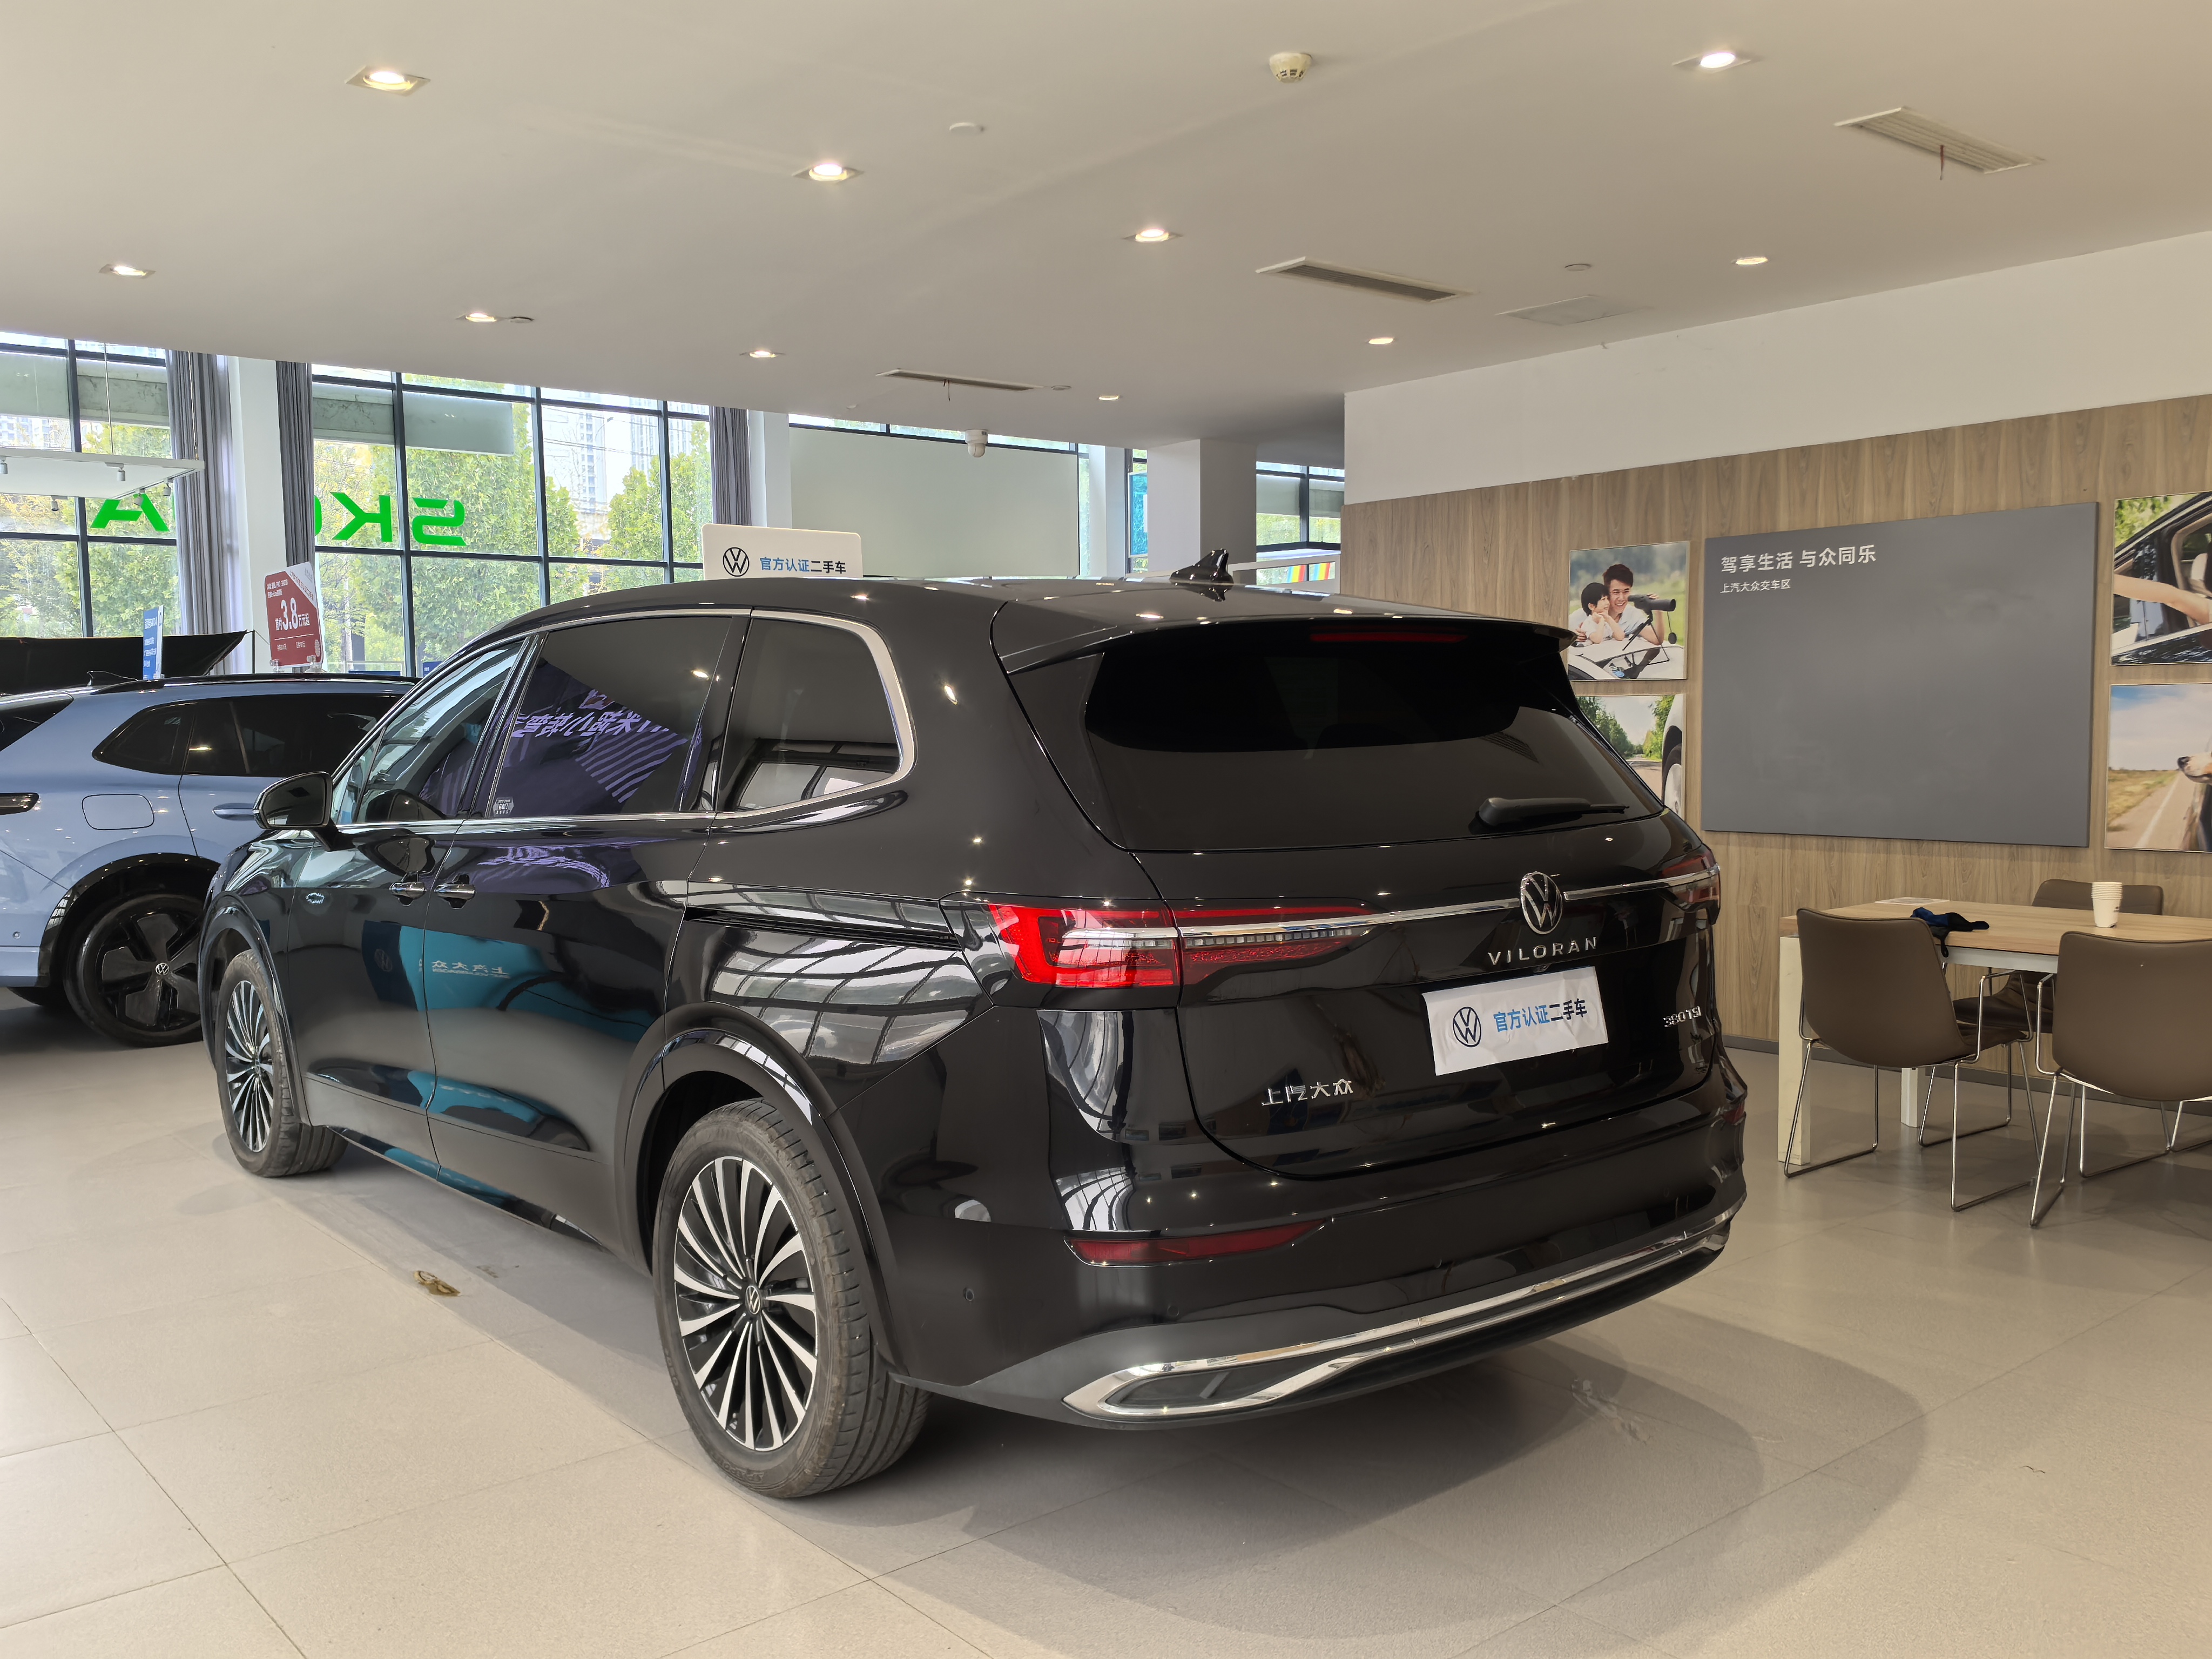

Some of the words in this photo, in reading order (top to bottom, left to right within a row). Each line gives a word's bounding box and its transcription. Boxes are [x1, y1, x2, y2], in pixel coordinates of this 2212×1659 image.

[760, 557, 846, 574] 官方认证二手车
[1721, 551, 1792, 573] 驾享生活
[1799, 544, 1876, 568] 与众同乐
[1720, 578, 1791, 594] 上汽大众交车区
[1487, 936, 1597, 966] VILORAN
[1493, 999, 1588, 1033] 官方认证二手车
[1261, 1078, 1354, 1106] 上汽大众
